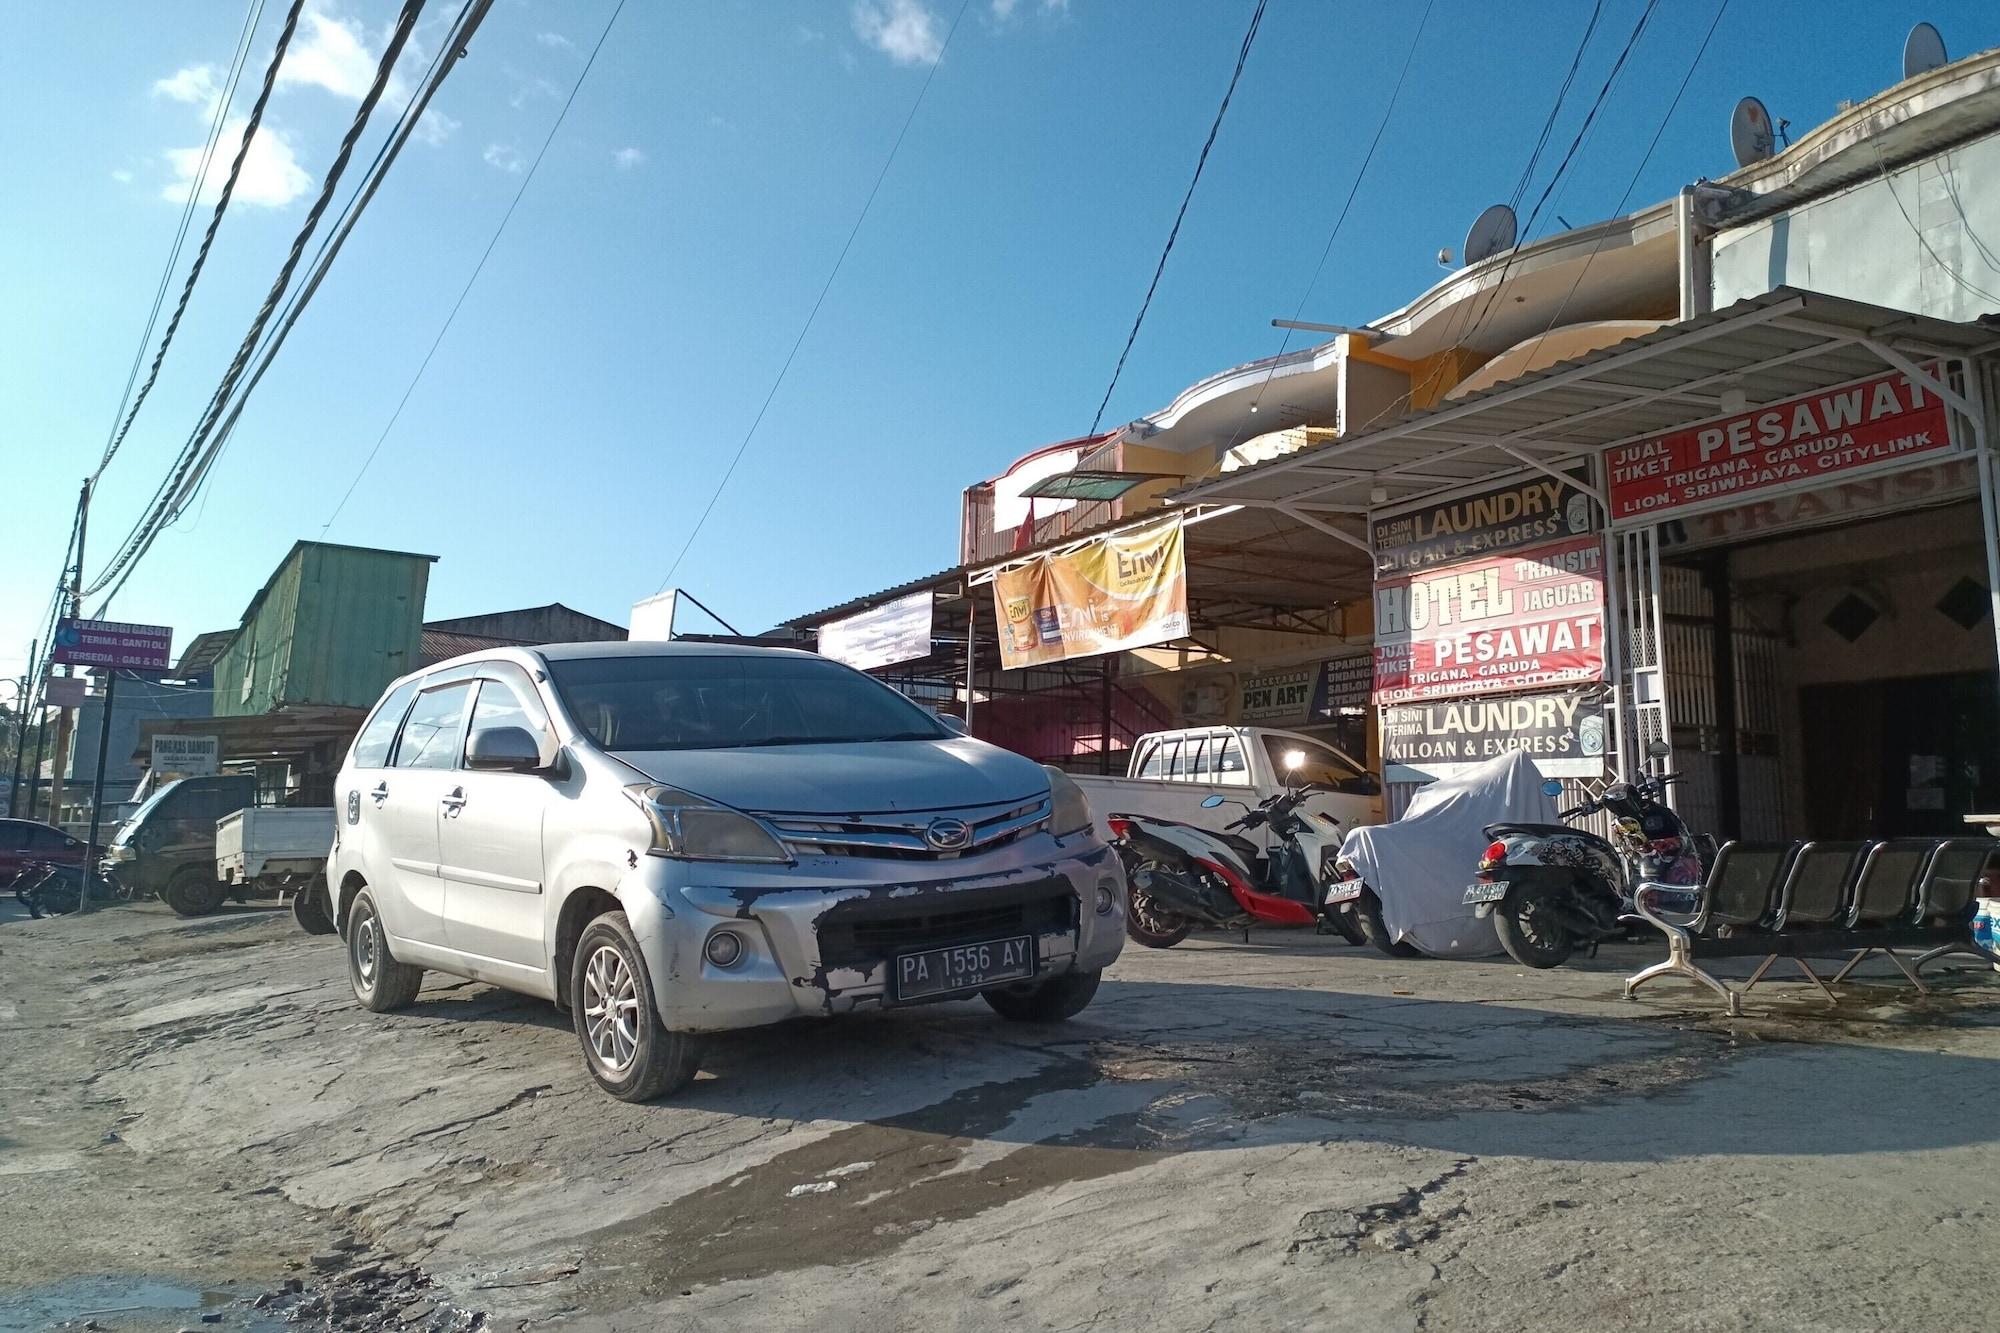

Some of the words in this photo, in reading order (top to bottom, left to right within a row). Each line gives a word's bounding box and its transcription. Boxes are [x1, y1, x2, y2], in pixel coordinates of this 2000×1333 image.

[1697, 370, 1933, 463] PESAWAT
[1615, 440, 1670, 466] JUAL
[1764, 432, 1855, 465] GARUDA
[1817, 431, 1933, 469] CITYLINK
[1613, 455, 1673, 484] TIKET
[1414, 479, 1566, 543] LAUNDRY
[1697, 462, 1969, 536] TRANSI
[1376, 525, 1389, 538] DI
[1391, 519, 1412, 534] SINI
[1378, 532, 1413, 550] TERIMA
[1383, 543, 1446, 571] KILOAN
[1454, 537, 1466, 555] &
[1471, 518, 1558, 551] EXPRESS
[1514, 547, 1600, 582] TRANSIT
[1378, 566, 1513, 635] HOTEL
[1522, 580, 1595, 613] JAGUAR
[81, 634, 117, 646] TERIMA
[122, 638, 151, 648] GANTI
[151, 641, 167, 650] OLI
[1378, 643, 1414, 660] JUAL
[1434, 617, 1598, 667] PESAWAT
[68, 651, 114, 663] TERSEDIA
[122, 655, 141, 665] GAS
[1376, 657, 1417, 675] TIKET
[1478, 658, 1541, 677] GARUDA
[1327, 666, 1374, 683] UNDANG
[1327, 680, 1370, 695] SABLON
[1243, 689, 1272, 709] PEN
[1276, 684, 1309, 706] ART
[1387, 722, 1424, 737] TERIMA
[1388, 711, 1400, 724] DI
[1401, 709, 1423, 723] SINI
[1426, 697, 1581, 736] LAUNDRY
[1391, 741, 1457, 760] KILOAN
[1464, 740, 1477, 756] &
[1484, 735, 1571, 756] EXPRESS
[903, 956, 929, 983] PA
[942, 946, 991, 976] 1556
[1002, 940, 1025, 967] AY
